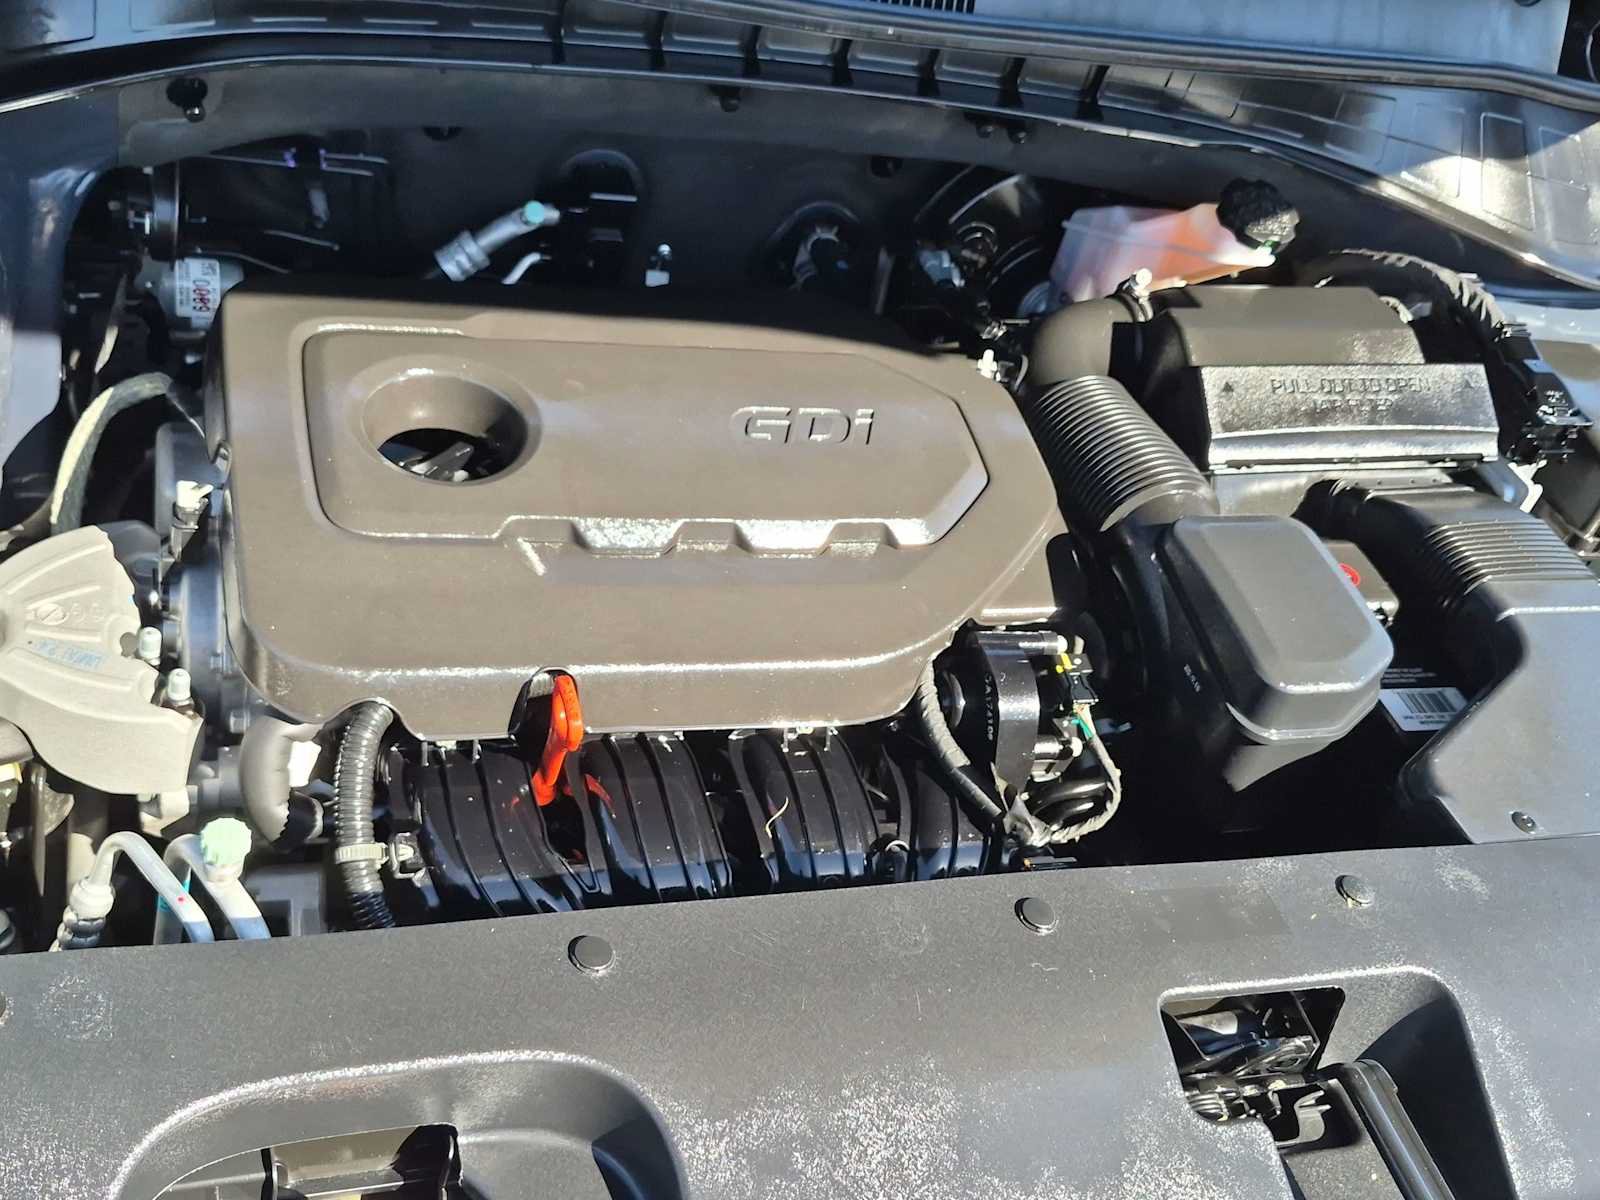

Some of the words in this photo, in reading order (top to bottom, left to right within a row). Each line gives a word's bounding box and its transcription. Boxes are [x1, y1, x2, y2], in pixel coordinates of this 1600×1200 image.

[1271, 378, 1319, 393] PULL
[1320, 378, 1353, 393] OUT
[1357, 378, 1381, 393] TO
[1385, 378, 1430, 393] OPEN
